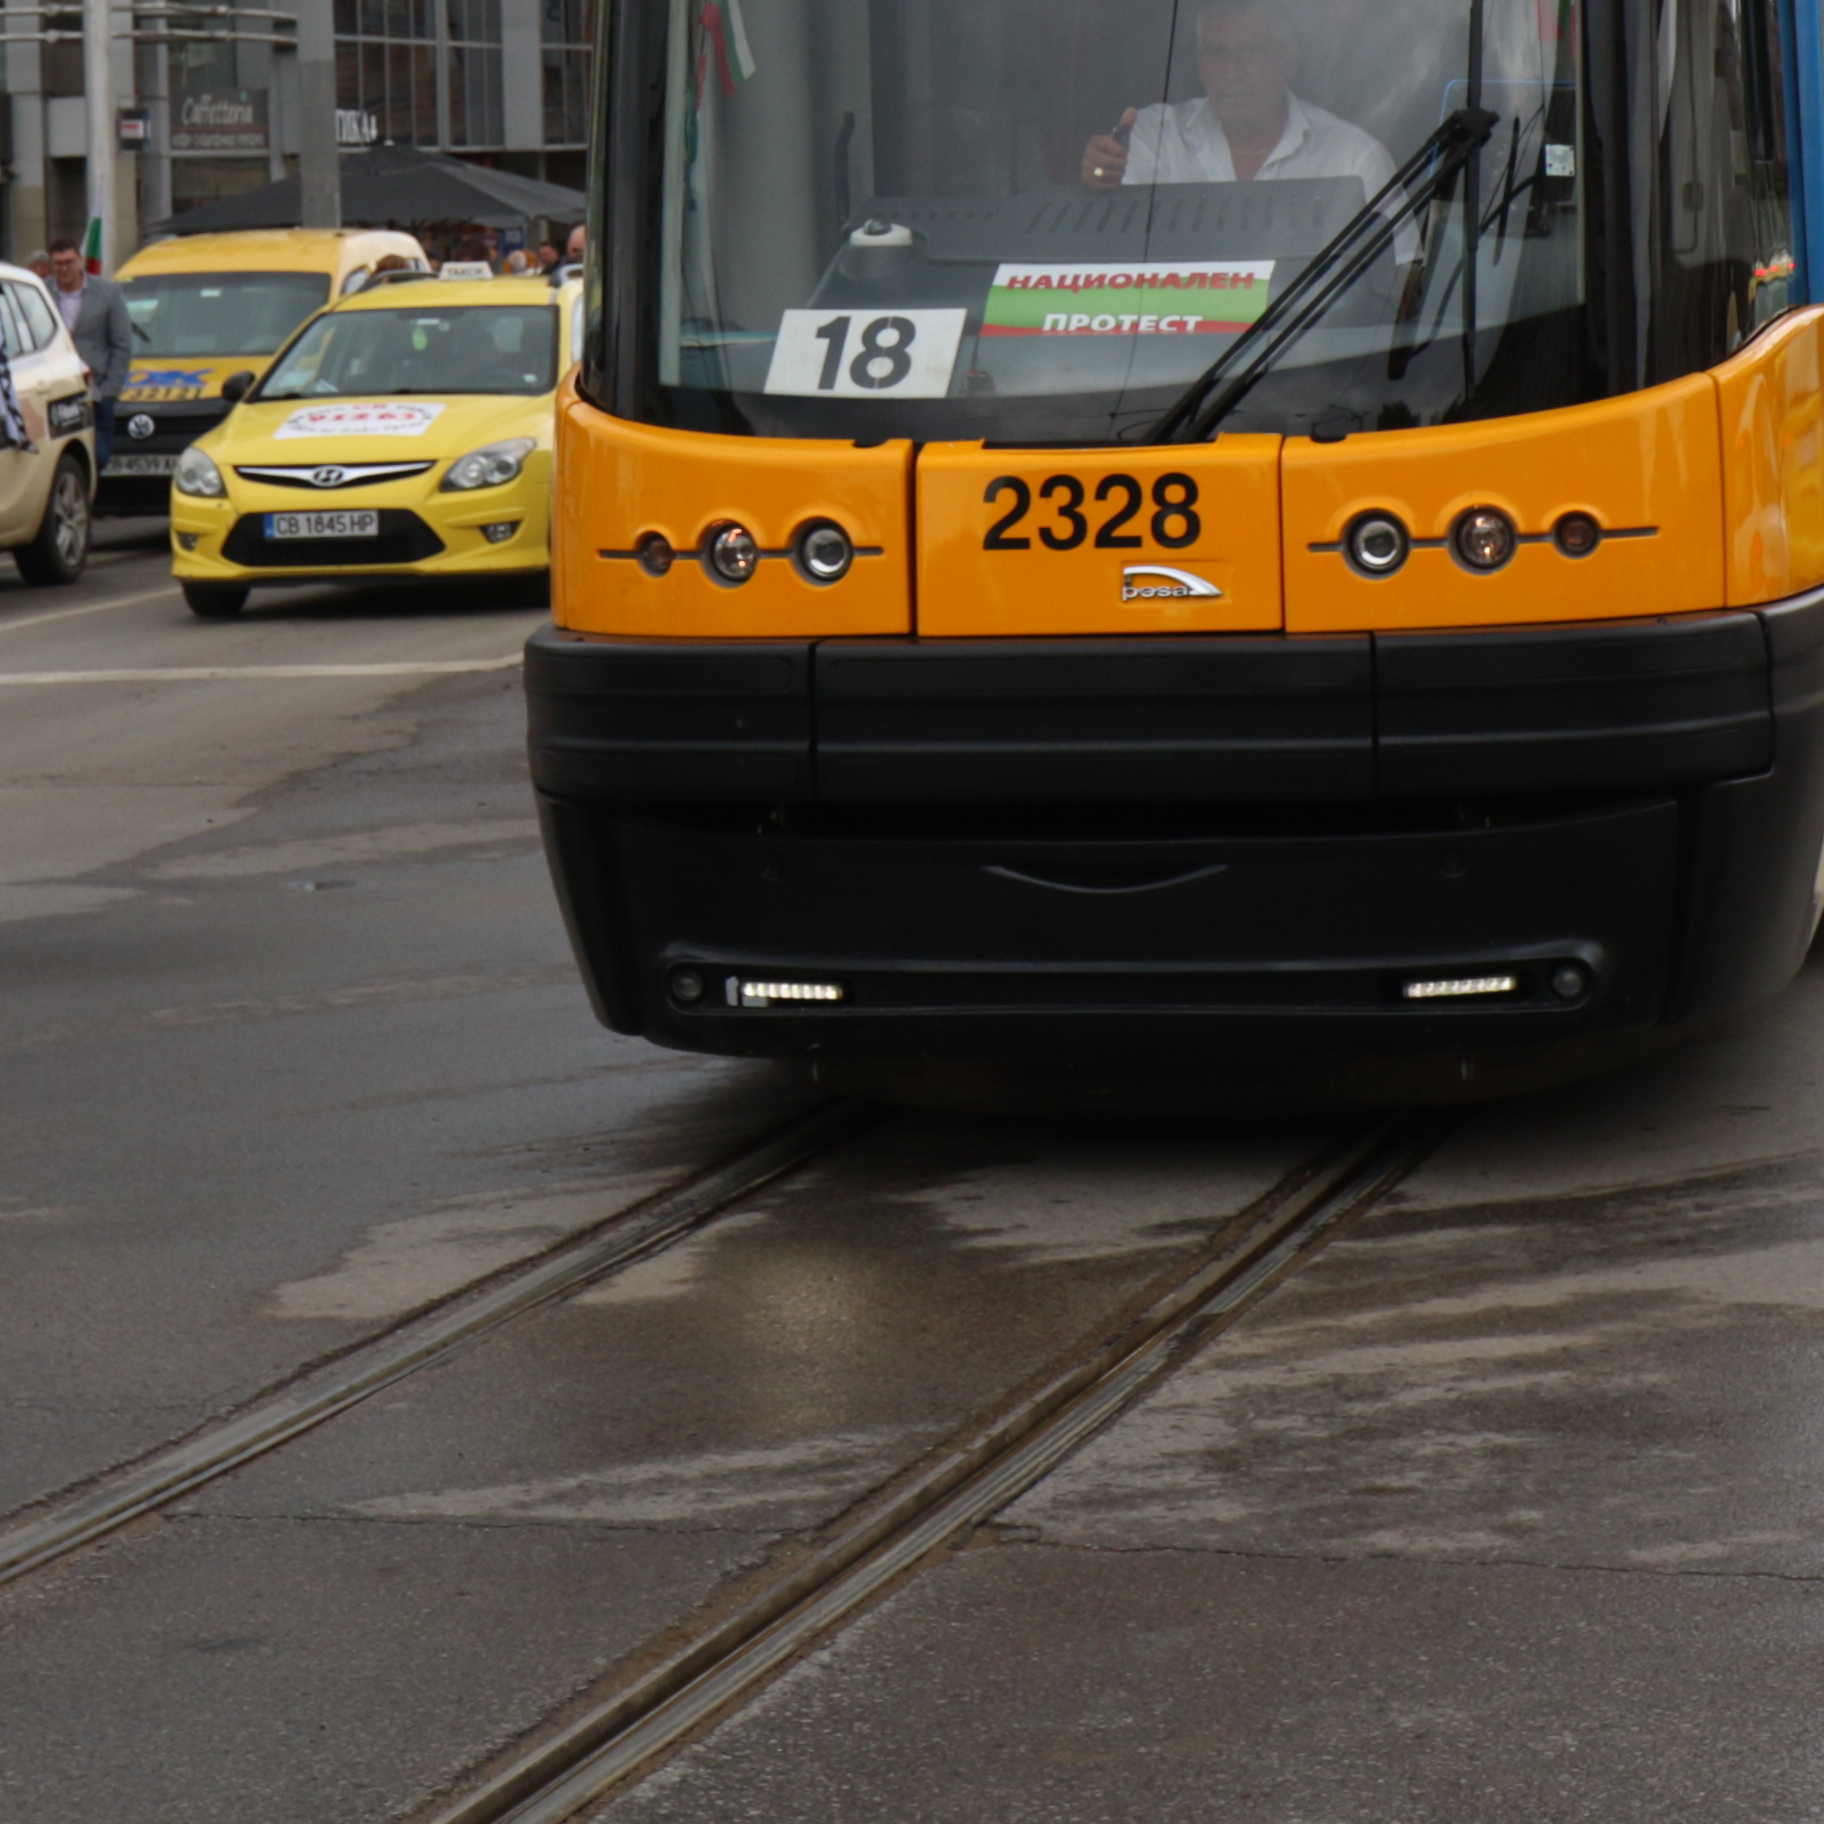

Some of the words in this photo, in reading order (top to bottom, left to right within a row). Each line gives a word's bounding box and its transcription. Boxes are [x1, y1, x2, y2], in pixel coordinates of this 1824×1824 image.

[1006, 271, 1256, 294] НАЦИОНАЛЕН
[1041, 313, 1204, 333] ПРОТЕСТ
[814, 314, 917, 390] 18
[982, 472, 1202, 551] 2328
[277, 516, 300, 535] CB
[305, 515, 348, 534] 1845
[351, 514, 375, 532] HP
